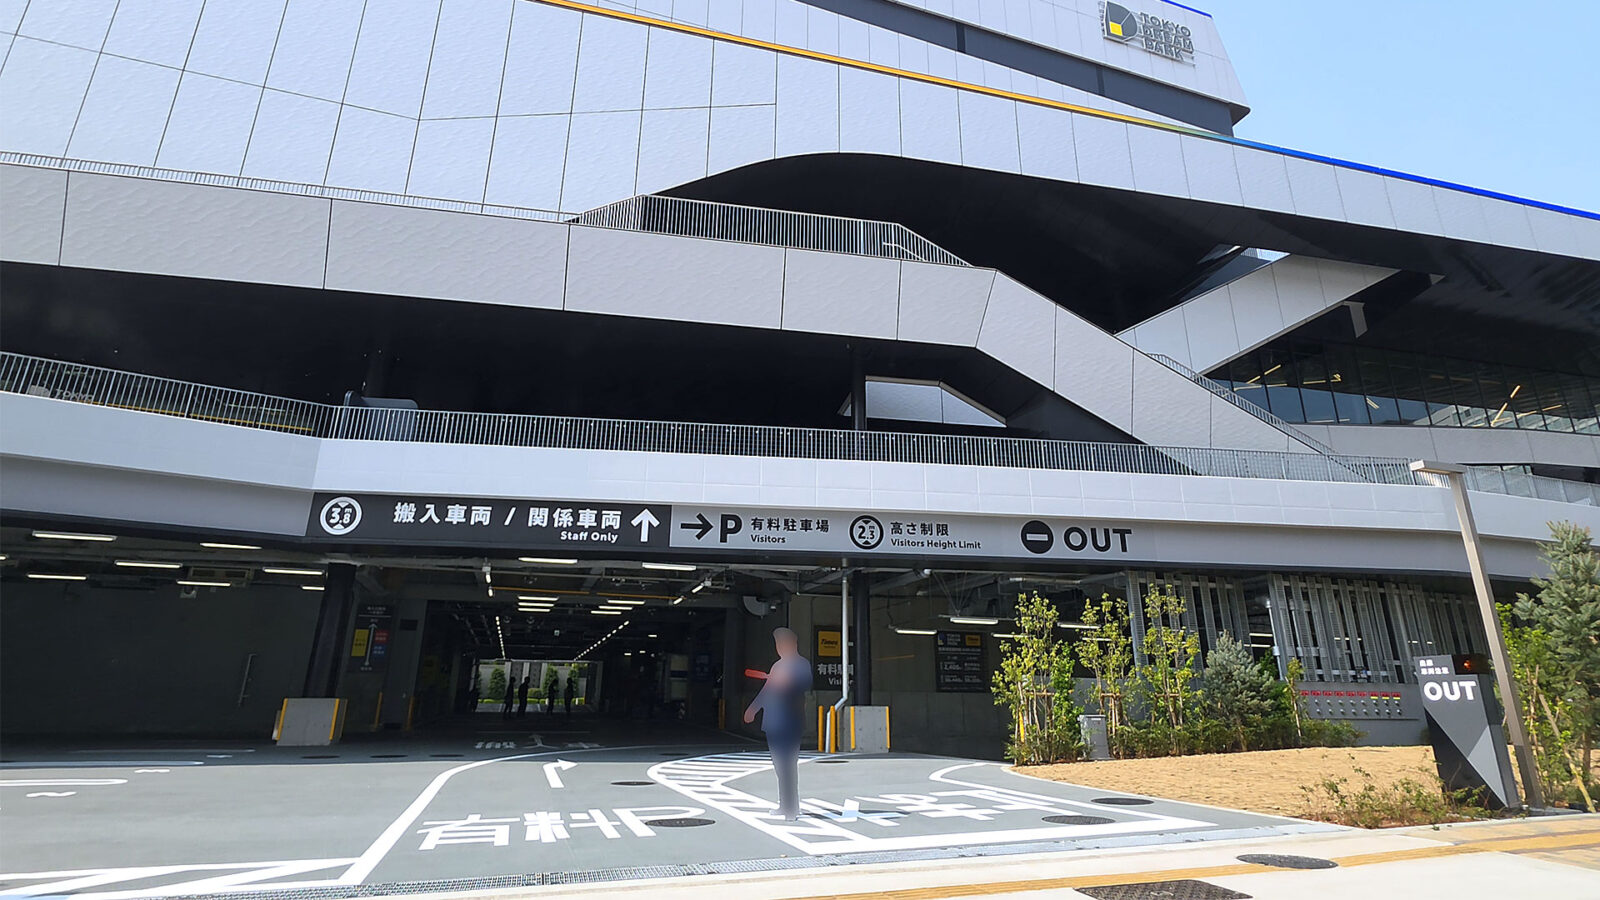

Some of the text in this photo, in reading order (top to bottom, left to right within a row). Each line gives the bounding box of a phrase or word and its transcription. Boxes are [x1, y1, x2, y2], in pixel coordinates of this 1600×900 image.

[1139, 11, 1191, 38] TOKYO
[1141, 24, 1195, 54] DREAM
[1143, 37, 1185, 62] PARK
[393, 502, 492, 526] 搬入車両
[527, 507, 622, 530] 関係車両
[720, 514, 830, 543] P 有料駐車場
[560, 530, 618, 543] Staff Only
[751, 534, 786, 543] Visitors
[890, 521, 949, 537] 高さ制限
[1063, 526, 1133, 553] OUT
[891, 538, 982, 550] Visitors Height Limit
[1423, 681, 1477, 701] OUT
